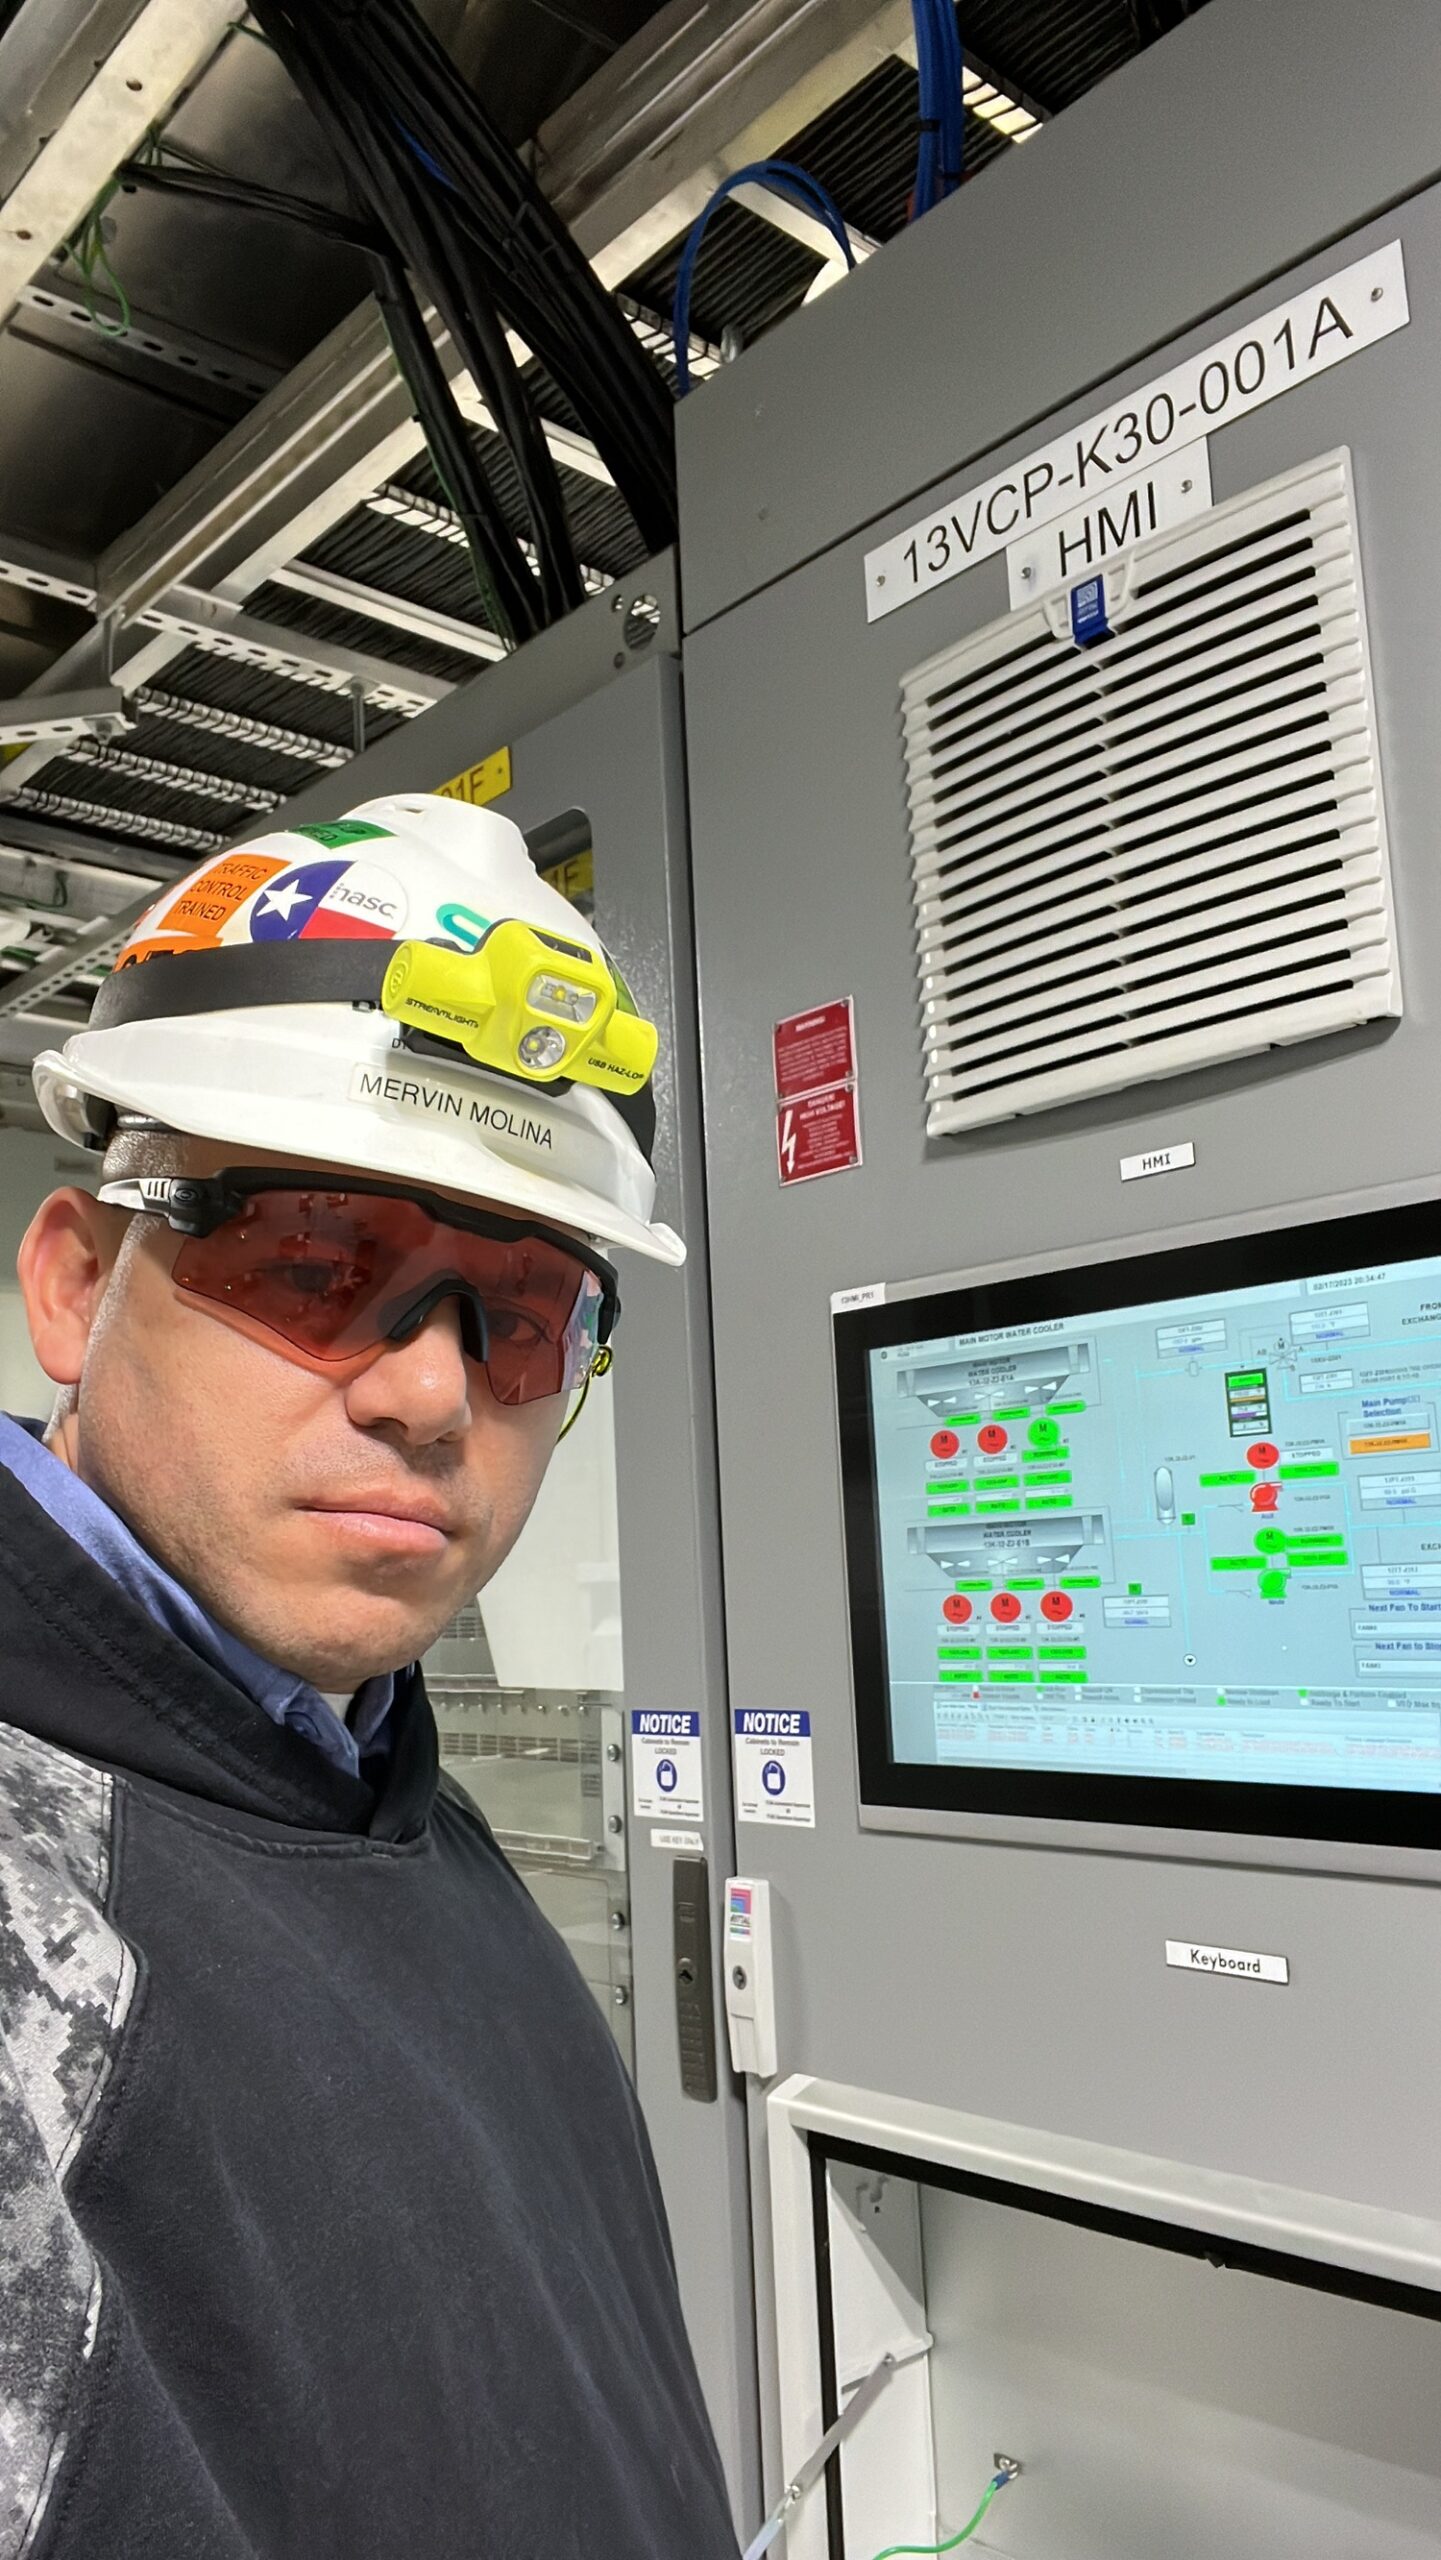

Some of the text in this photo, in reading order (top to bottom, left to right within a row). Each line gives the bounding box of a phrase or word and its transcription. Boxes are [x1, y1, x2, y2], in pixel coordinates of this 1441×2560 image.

[903, 297, 1354, 584] 13VCP-K30-001A
[1058, 481, 1157, 578] HMI
[220, 862, 268, 880] TRAFFIC
[190, 880, 248, 901] CONTROL
[176, 900, 227, 921] TRAINED
[588, 1057, 607, 1069] USB
[360, 1073, 553, 1150] MERVIN MOLINA
[1142, 1153, 1171, 1171] HMI
[959, 1337, 977, 1347] MAIN
[978, 1332, 1006, 1344] MOTOR
[1033, 1322, 1065, 1334] COOLER
[640, 1713, 692, 1734] NOTICE
[743, 1712, 801, 1734] NOTICE
[1190, 1949, 1261, 1974] Keyboard
